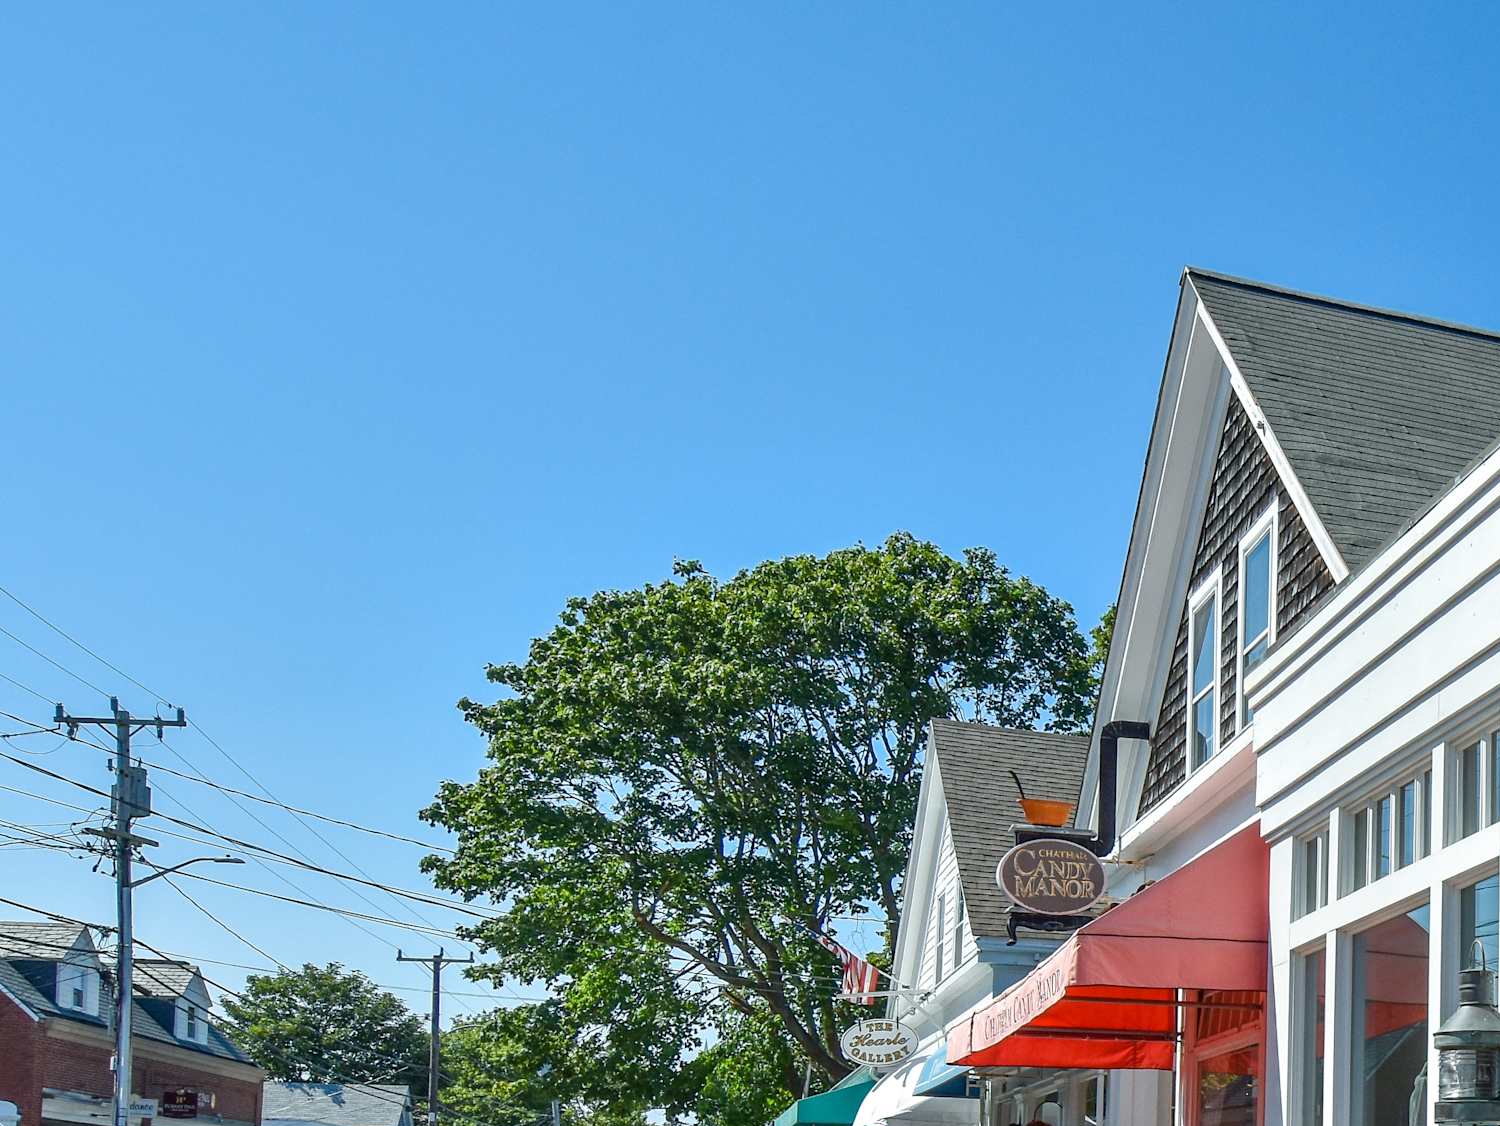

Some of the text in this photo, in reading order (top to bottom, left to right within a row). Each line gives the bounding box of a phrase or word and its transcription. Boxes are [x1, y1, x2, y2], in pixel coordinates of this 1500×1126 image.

[1013, 848, 1095, 880] CANDY
[1014, 875, 1095, 899] MANOR
[866, 1022, 894, 1033] THE
[851, 1047, 910, 1063] GALLERY
